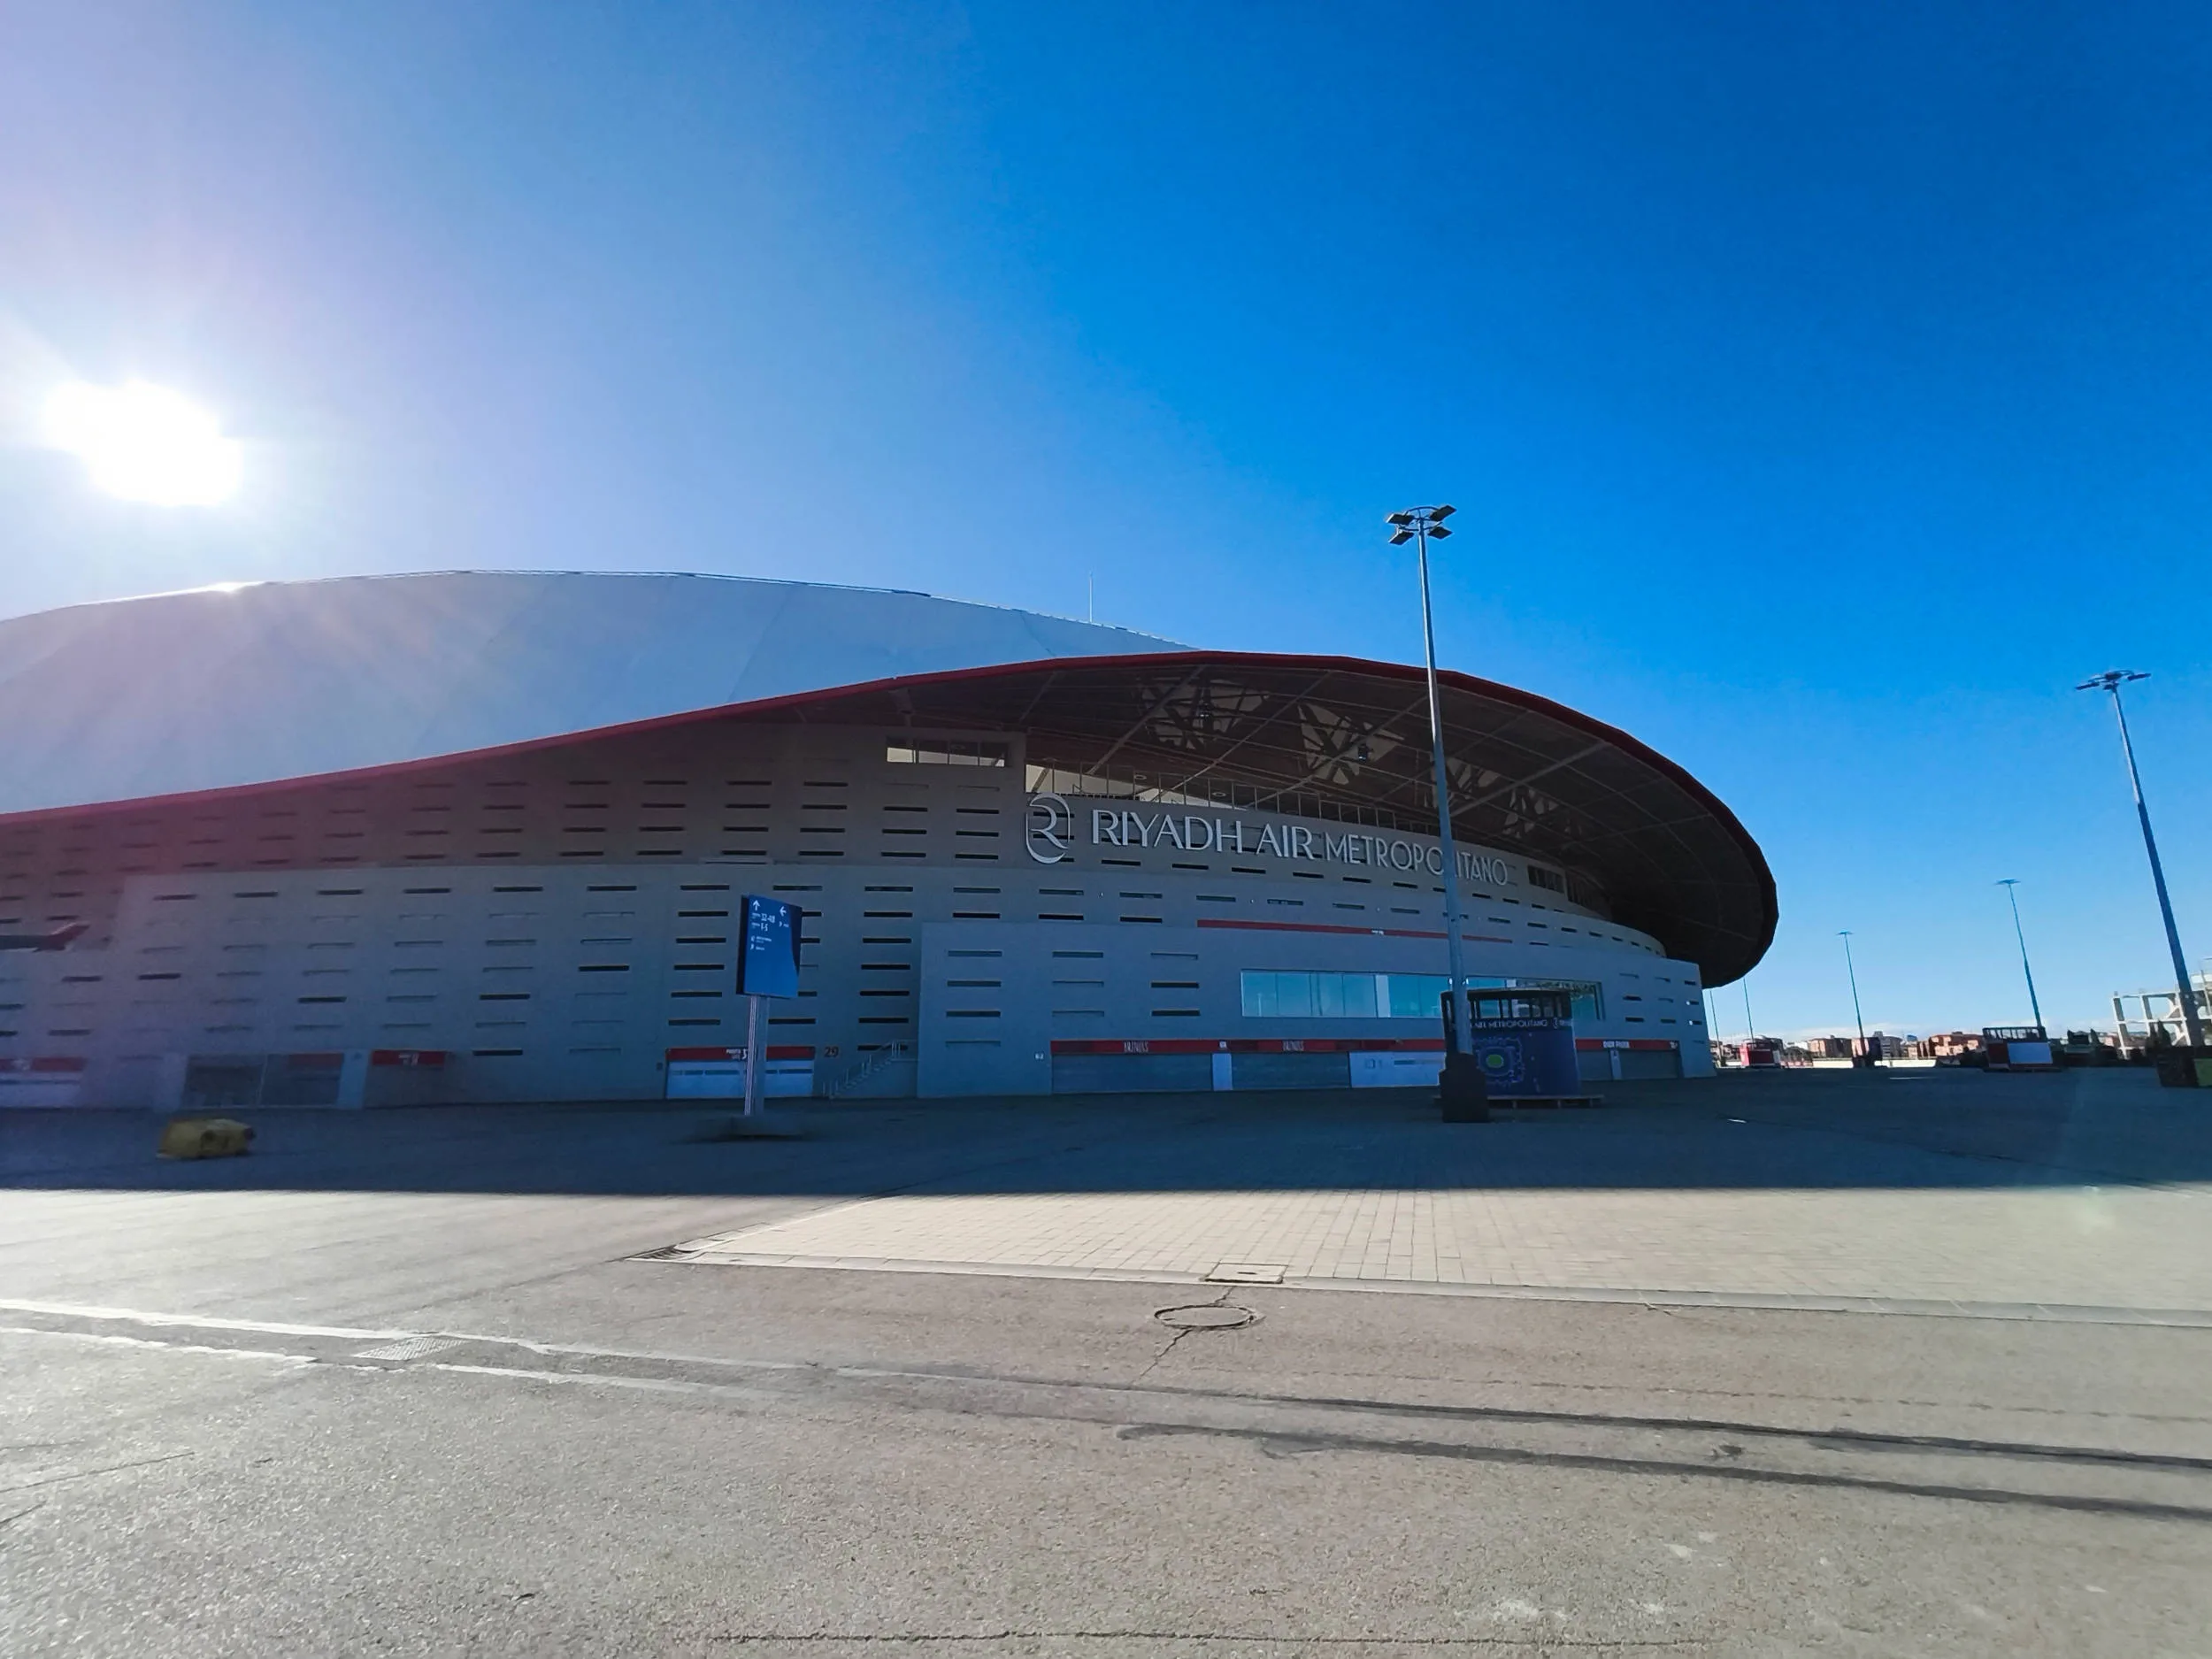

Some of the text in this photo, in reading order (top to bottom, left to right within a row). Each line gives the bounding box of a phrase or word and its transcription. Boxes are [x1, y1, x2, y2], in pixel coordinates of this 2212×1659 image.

[1092, 809, 1243, 854] RIYADH
[1256, 823, 1317, 861] AIR
[1324, 831, 1509, 887] METROPOITANO
